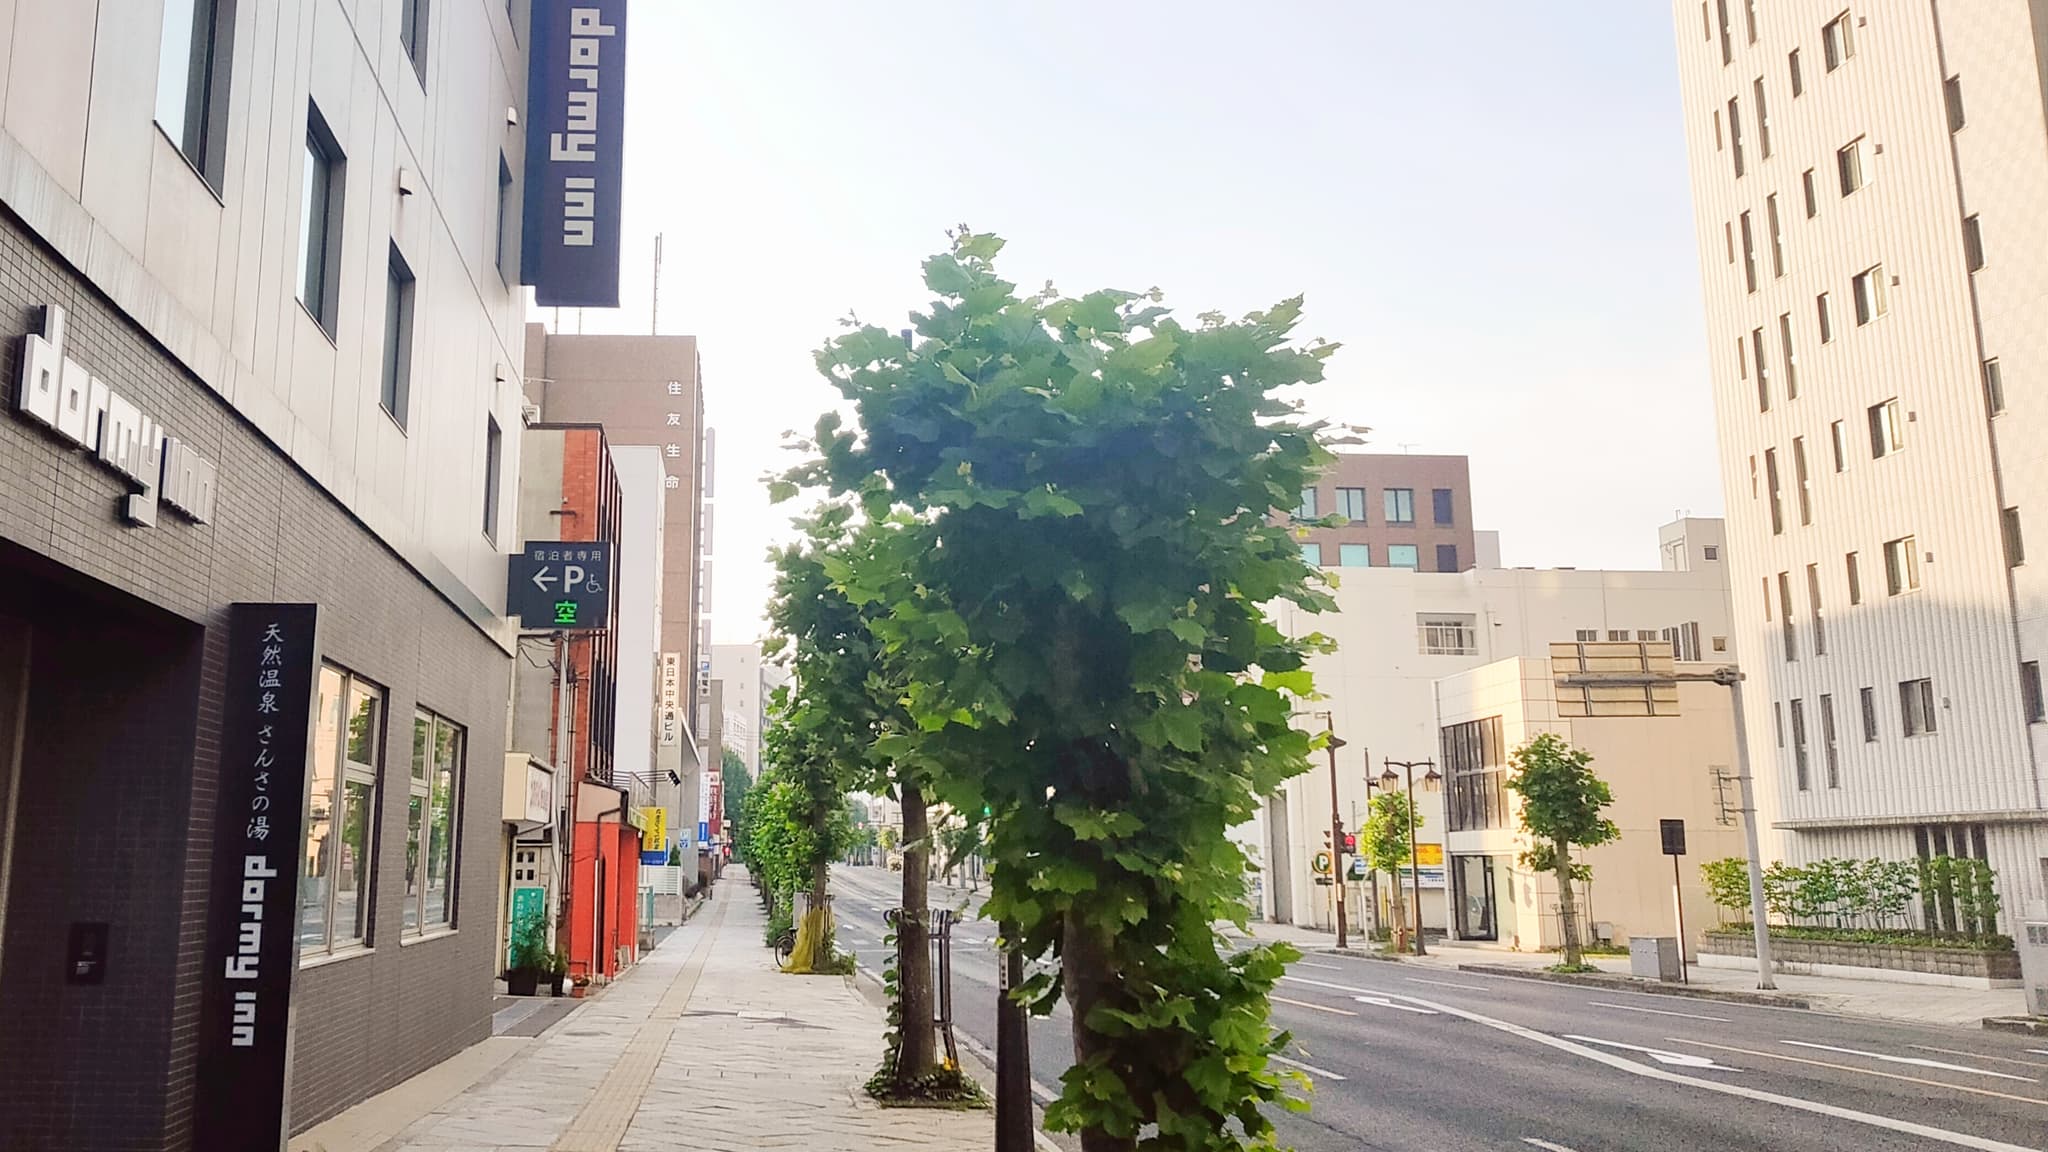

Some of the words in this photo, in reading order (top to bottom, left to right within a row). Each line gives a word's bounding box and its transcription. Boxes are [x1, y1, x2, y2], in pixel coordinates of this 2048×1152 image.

[551, 8, 615, 161] dormy
[564, 177, 595, 246] inn
[20, 303, 163, 528] dormy
[162, 436, 216, 525] inn
[665, 381, 682, 489] 住友生命
[554, 601, 577, 623] 空
[564, 565, 584, 593] P
[257, 623, 284, 713] 天然温泉
[664, 657, 675, 741] 東日本中央通ビル
[246, 725, 274, 841] さんさの湯
[225, 856, 277, 978] dormy
[232, 992, 256, 1046] inn
